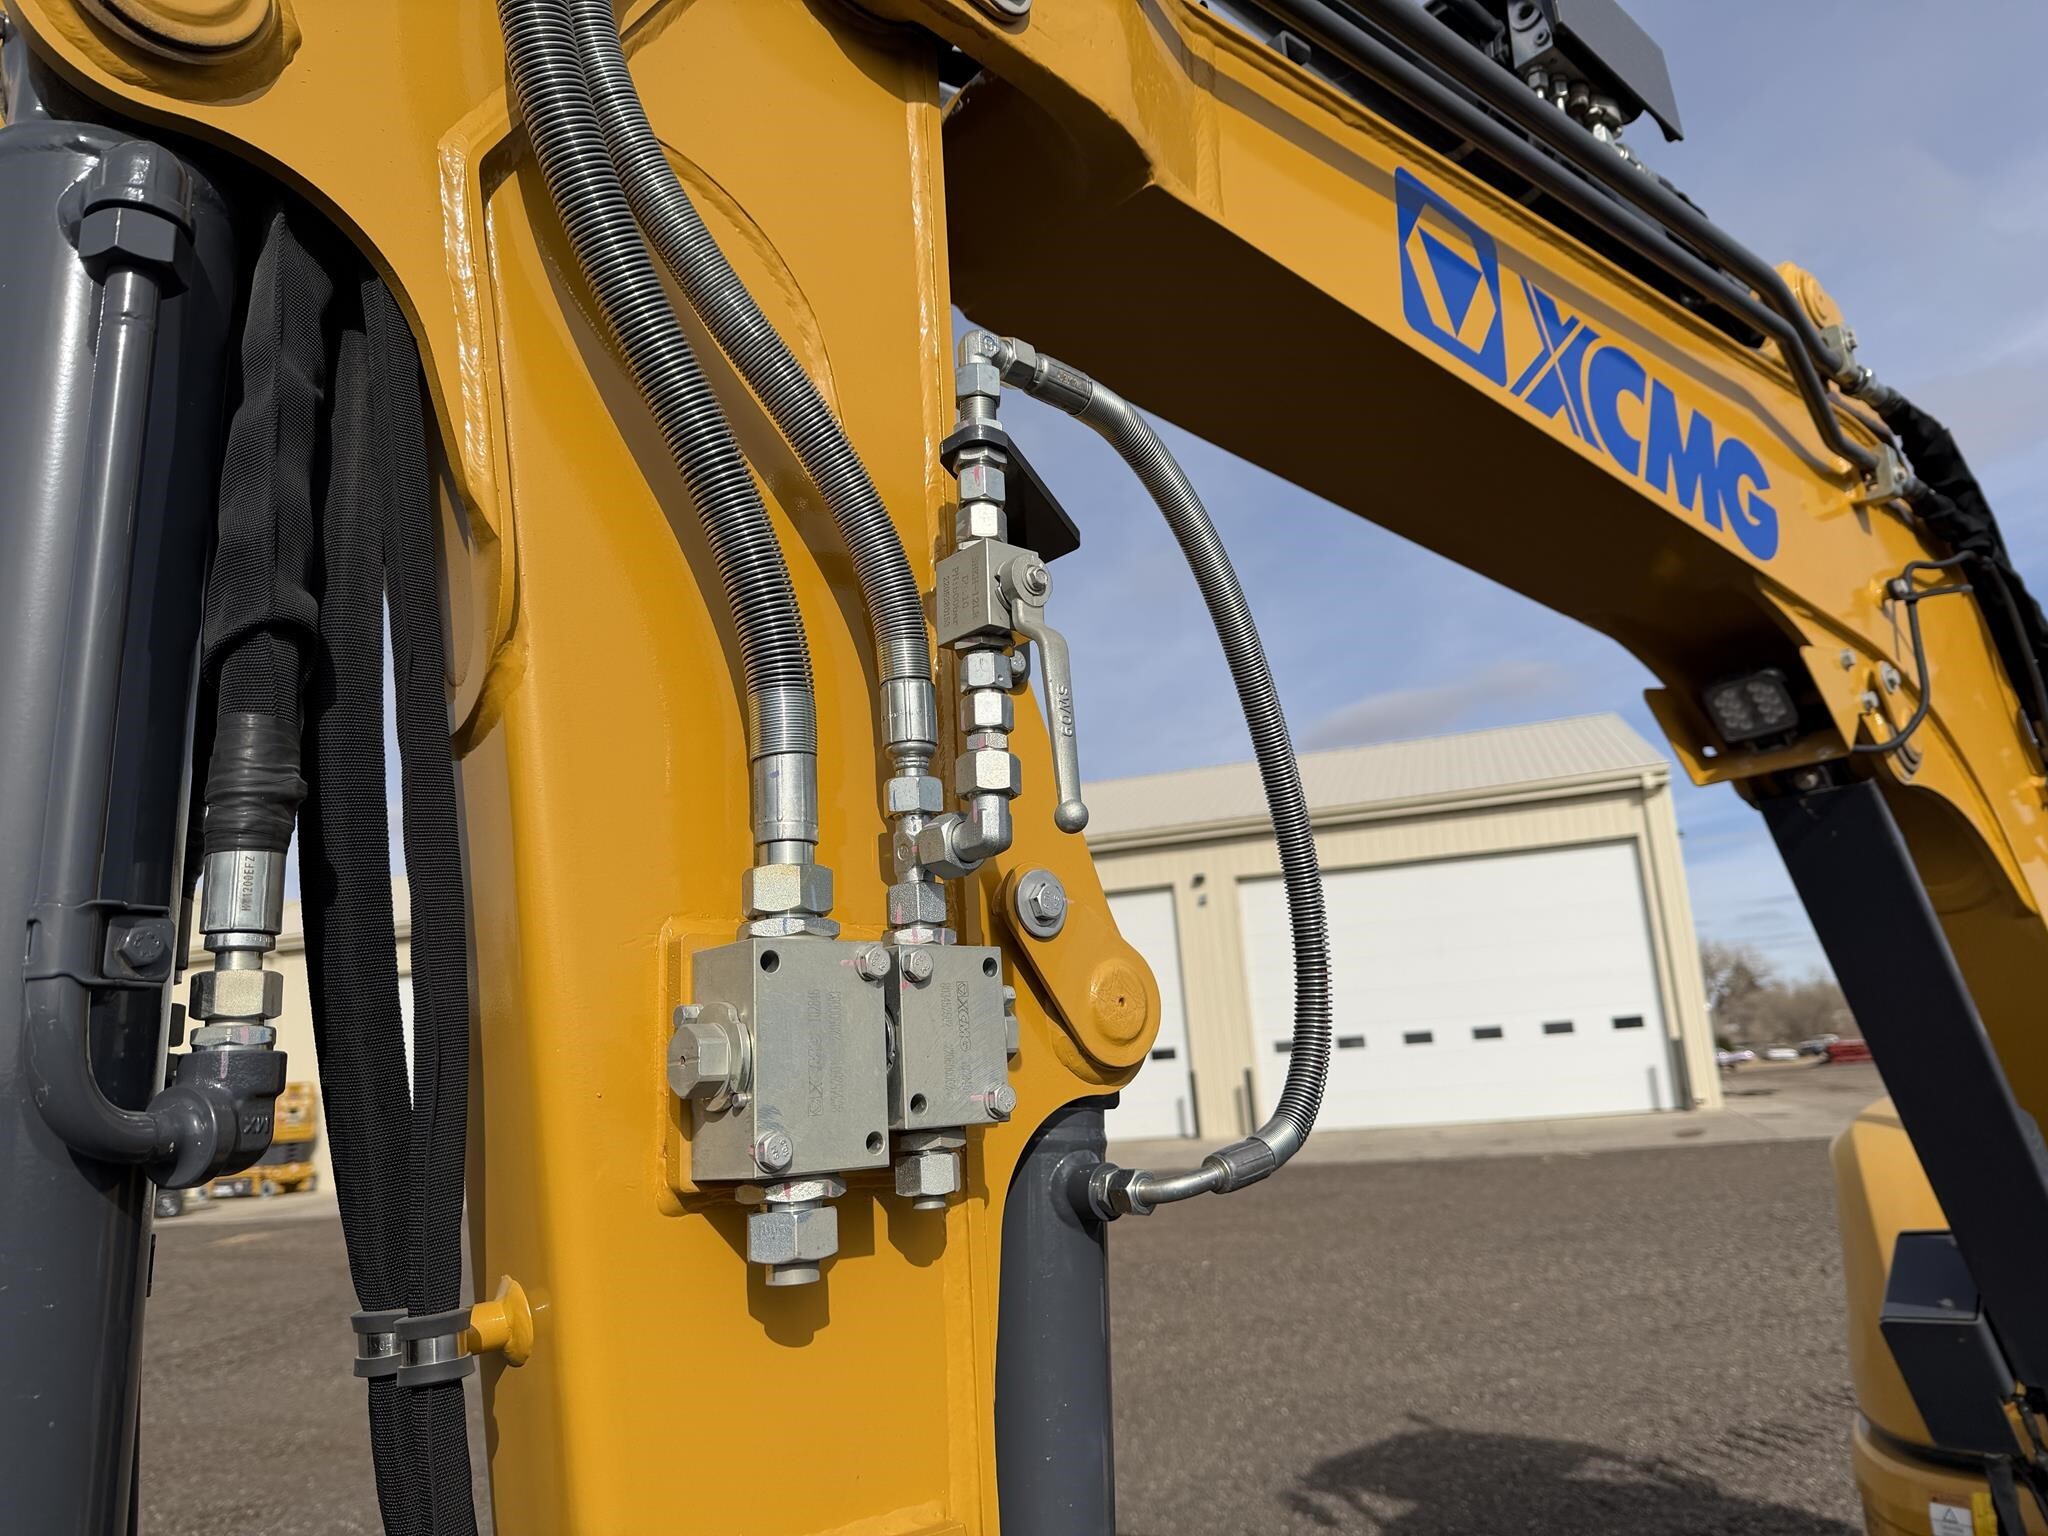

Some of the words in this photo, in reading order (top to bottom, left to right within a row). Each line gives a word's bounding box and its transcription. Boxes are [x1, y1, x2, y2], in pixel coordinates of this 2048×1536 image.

[1509, 275, 1779, 561] XCMG
[1057, 684, 1073, 738] SW09
[957, 998, 972, 1053] XCMG
